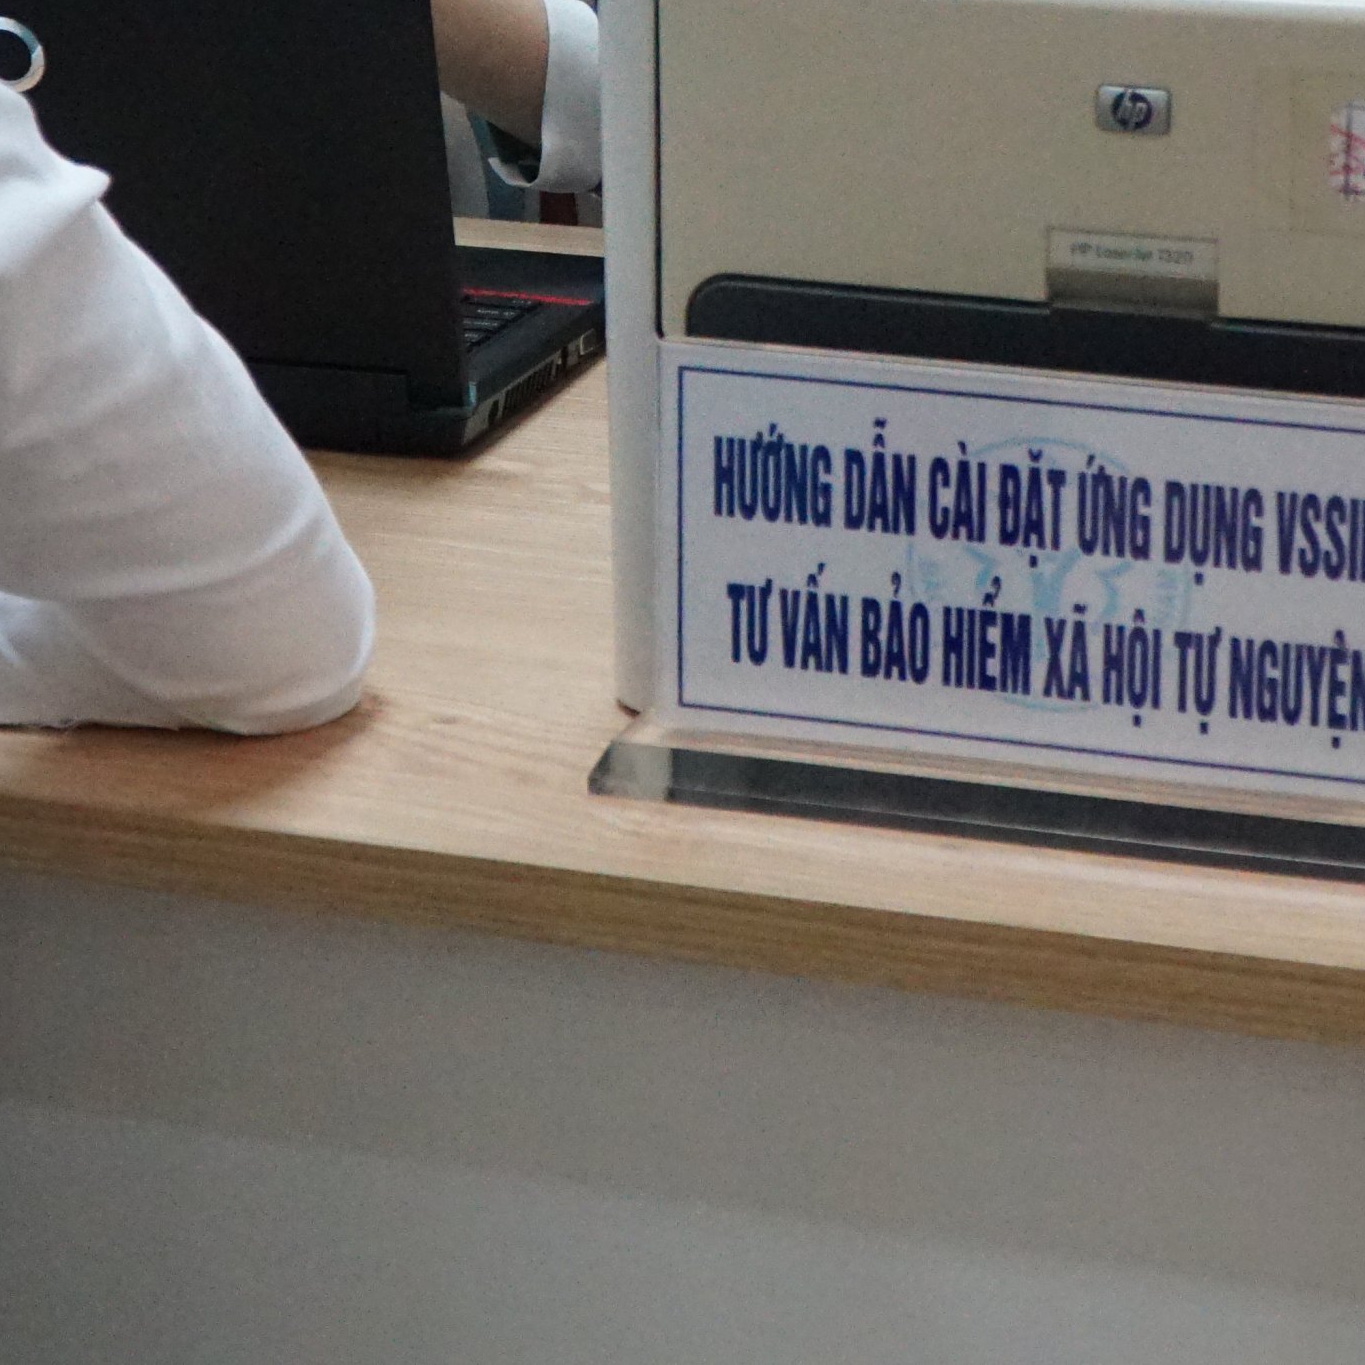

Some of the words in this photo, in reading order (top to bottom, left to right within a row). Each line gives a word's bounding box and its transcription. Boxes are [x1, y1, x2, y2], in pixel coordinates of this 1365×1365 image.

[714, 422, 833, 528] HƯỚNG
[844, 418, 917, 537] DẪN
[928, 441, 987, 544] CÀI
[998, 449, 1067, 569] ĐẶT
[1078, 454, 1152, 561] ỨNG
[1164, 481, 1263, 586] DỤNG
[727, 577, 774, 666] TƯ
[780, 562, 850, 675] VẤN
[861, 572, 931, 685] BẢO
[942, 575, 1033, 696] HIỂM
[1043, 604, 1091, 702] XÃ
[1103, 608, 1162, 727] HỘI
[1174, 627, 1223, 734] TỰ
